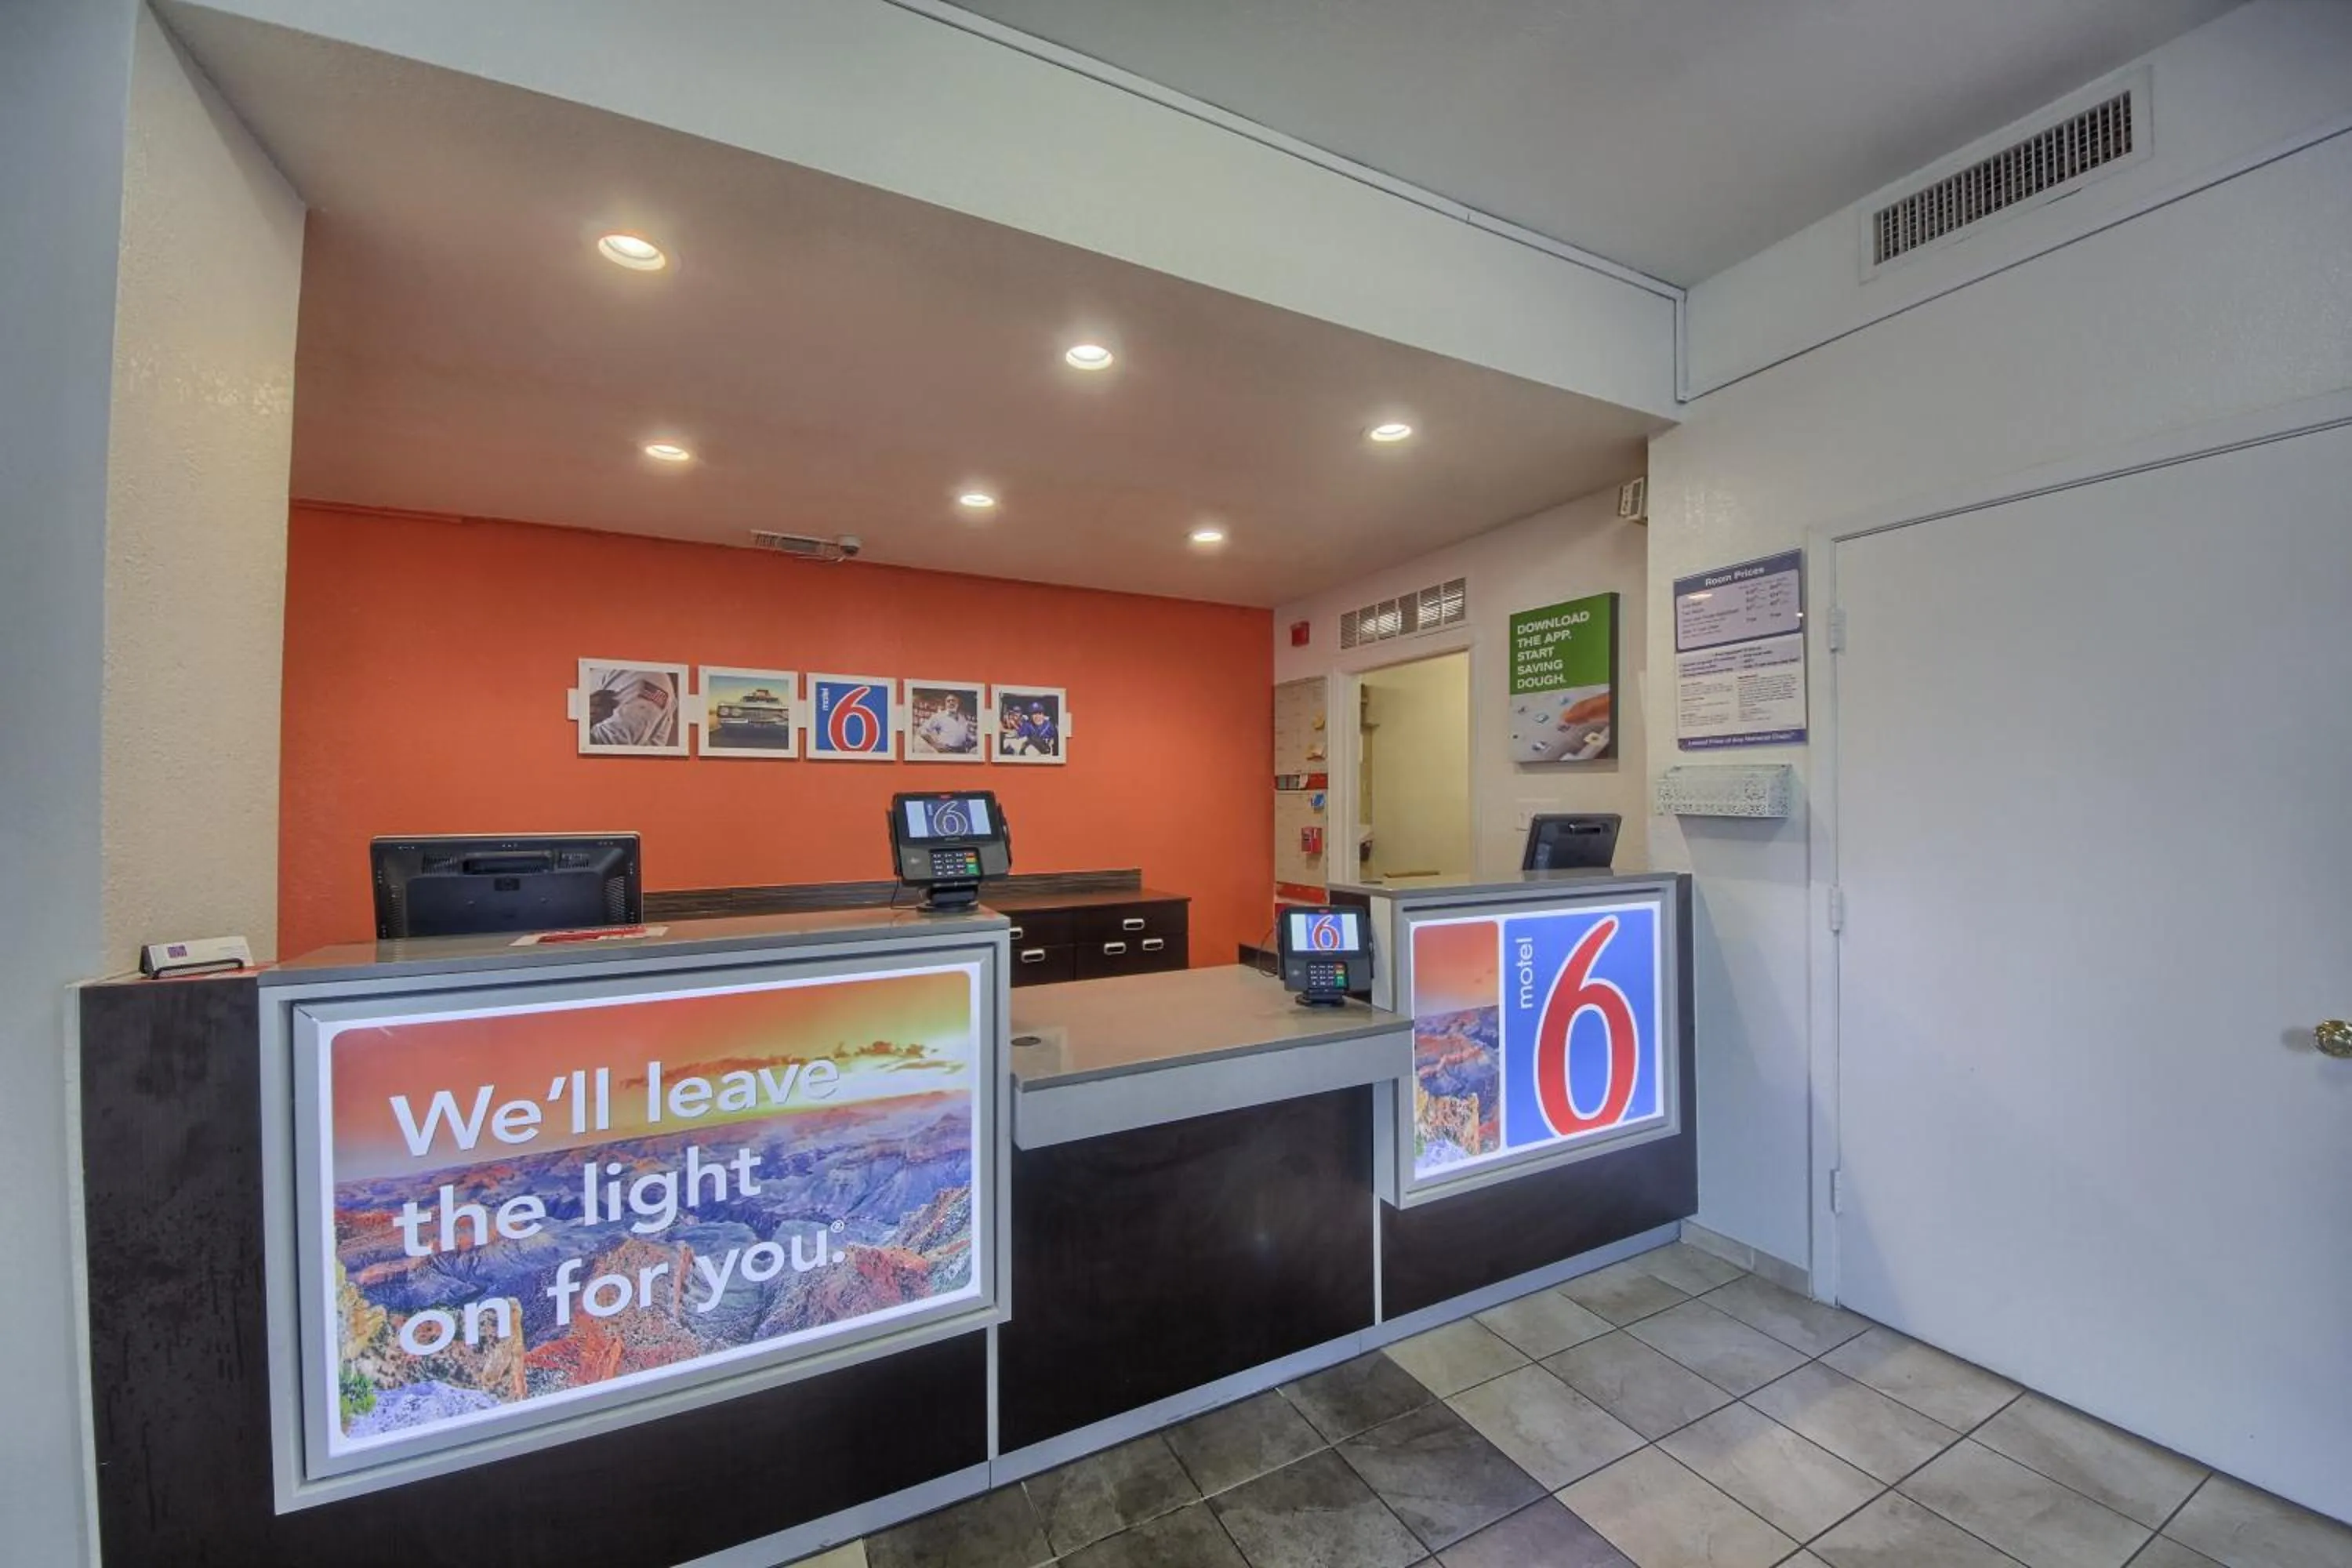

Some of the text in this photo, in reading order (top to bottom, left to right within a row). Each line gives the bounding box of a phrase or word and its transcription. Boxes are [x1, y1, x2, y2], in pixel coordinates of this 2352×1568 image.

[1705, 567, 1765, 587] Room Prices
[1517, 611, 1590, 635] DOWNLOAD
[1517, 630, 1572, 648] THE APP.
[1517, 646, 1554, 662] START
[1517, 659, 1563, 675] SAVING
[1517, 673, 1566, 689] DOUGH.
[828, 686, 880, 753] 6
[934, 800, 968, 836] 6
[1312, 914, 1340, 950] 6
[1515, 937, 1534, 1009] motel
[1534, 915, 1639, 1138] 6
[390, 1057, 840, 1157] We'll leave
[394, 1146, 762, 1257] the light
[399, 1298, 512, 1356] on
[547, 1258, 669, 1327] for
